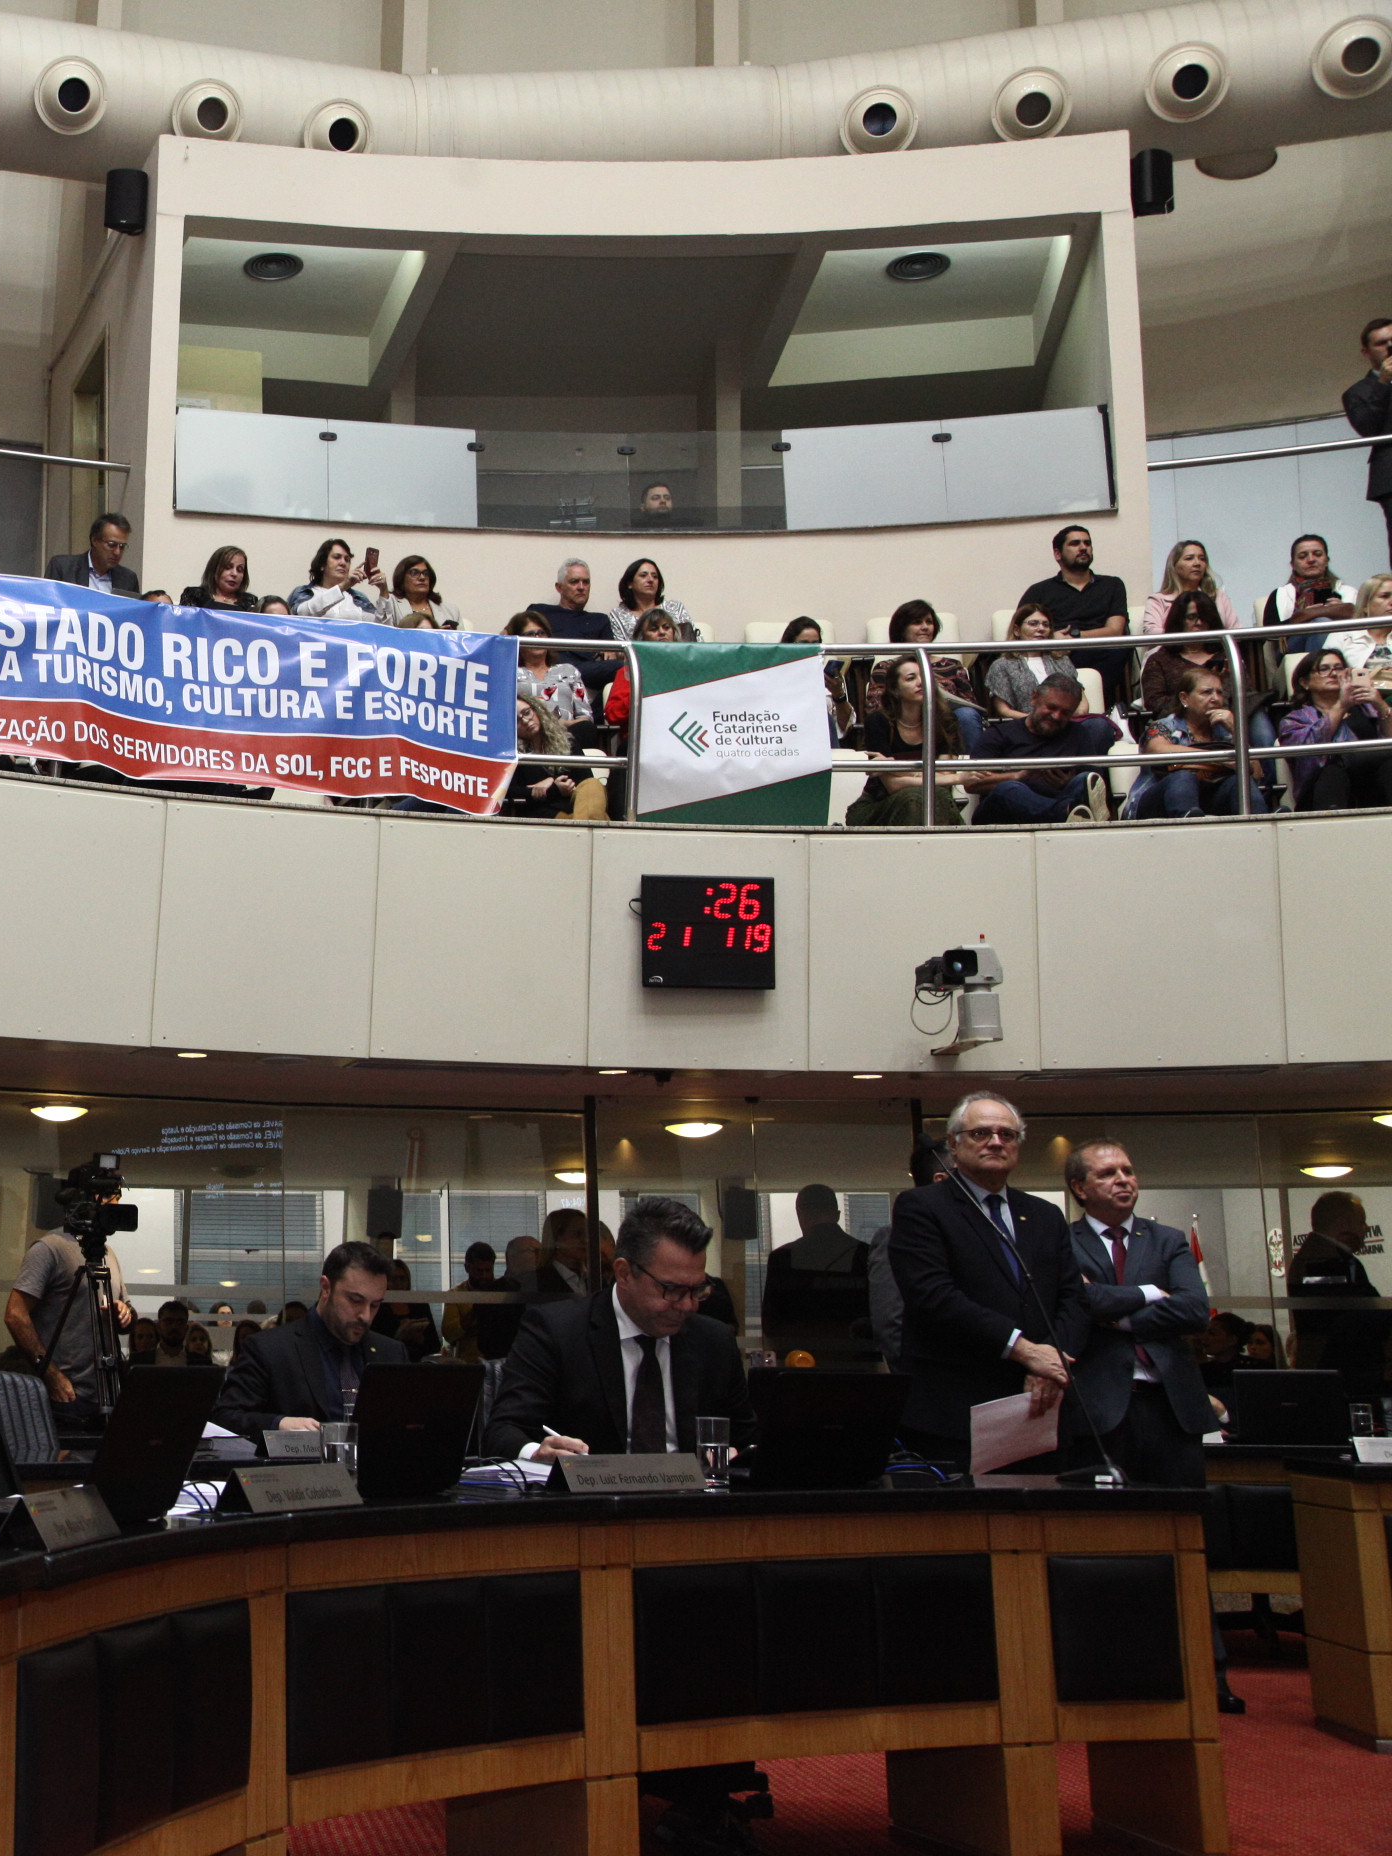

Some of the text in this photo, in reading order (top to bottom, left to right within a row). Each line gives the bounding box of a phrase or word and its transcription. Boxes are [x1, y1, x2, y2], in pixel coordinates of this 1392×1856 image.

[162, 632, 279, 686] RICO
[299, 642, 329, 687] E
[347, 643, 489, 711] FORTE
[32, 653, 173, 715] TURISMO,
[182, 683, 325, 719] CULTURA
[335, 690, 354, 720] E
[364, 691, 488, 743] ESPORTE
[712, 710, 780, 724] Fundação
[713, 722, 798, 734] Catarinense
[715, 735, 732, 746] de
[73, 721, 109, 749] DOS
[112, 735, 235, 772] SERVIDORES
[241, 752, 270, 775] DA
[275, 753, 324, 781] SOL,
[330, 756, 372, 778] FCC
[379, 755, 392, 777] E
[399, 757, 489, 798] FESPORTE
[716, 747, 800, 759] quatro décadas
[284, 1444, 321, 1454] Dep. Marc
[576, 1472, 695, 1487] Dep. Luiz Fernando Vampiro
